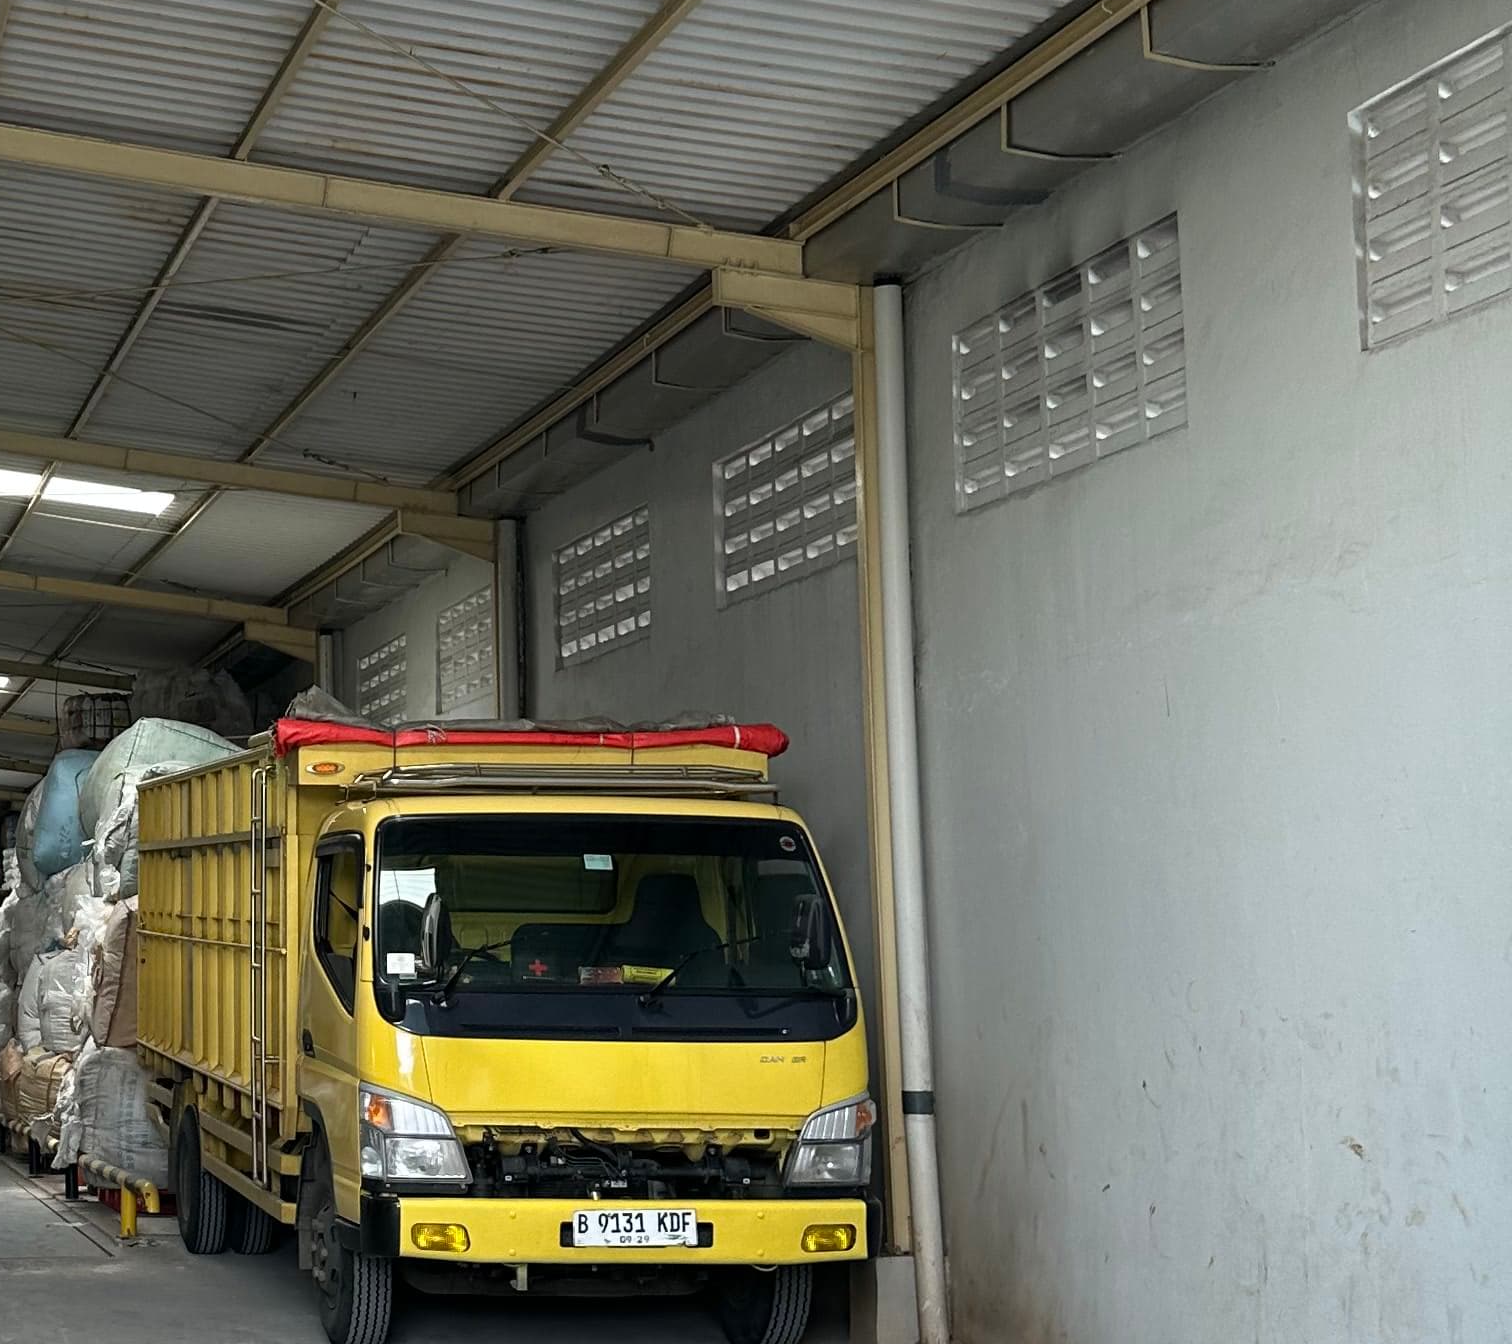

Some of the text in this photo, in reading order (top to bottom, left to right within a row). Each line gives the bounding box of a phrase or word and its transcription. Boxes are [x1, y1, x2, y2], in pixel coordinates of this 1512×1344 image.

[577, 1212, 692, 1234] B 9131 KDF
[619, 1235, 632, 1244] 09
